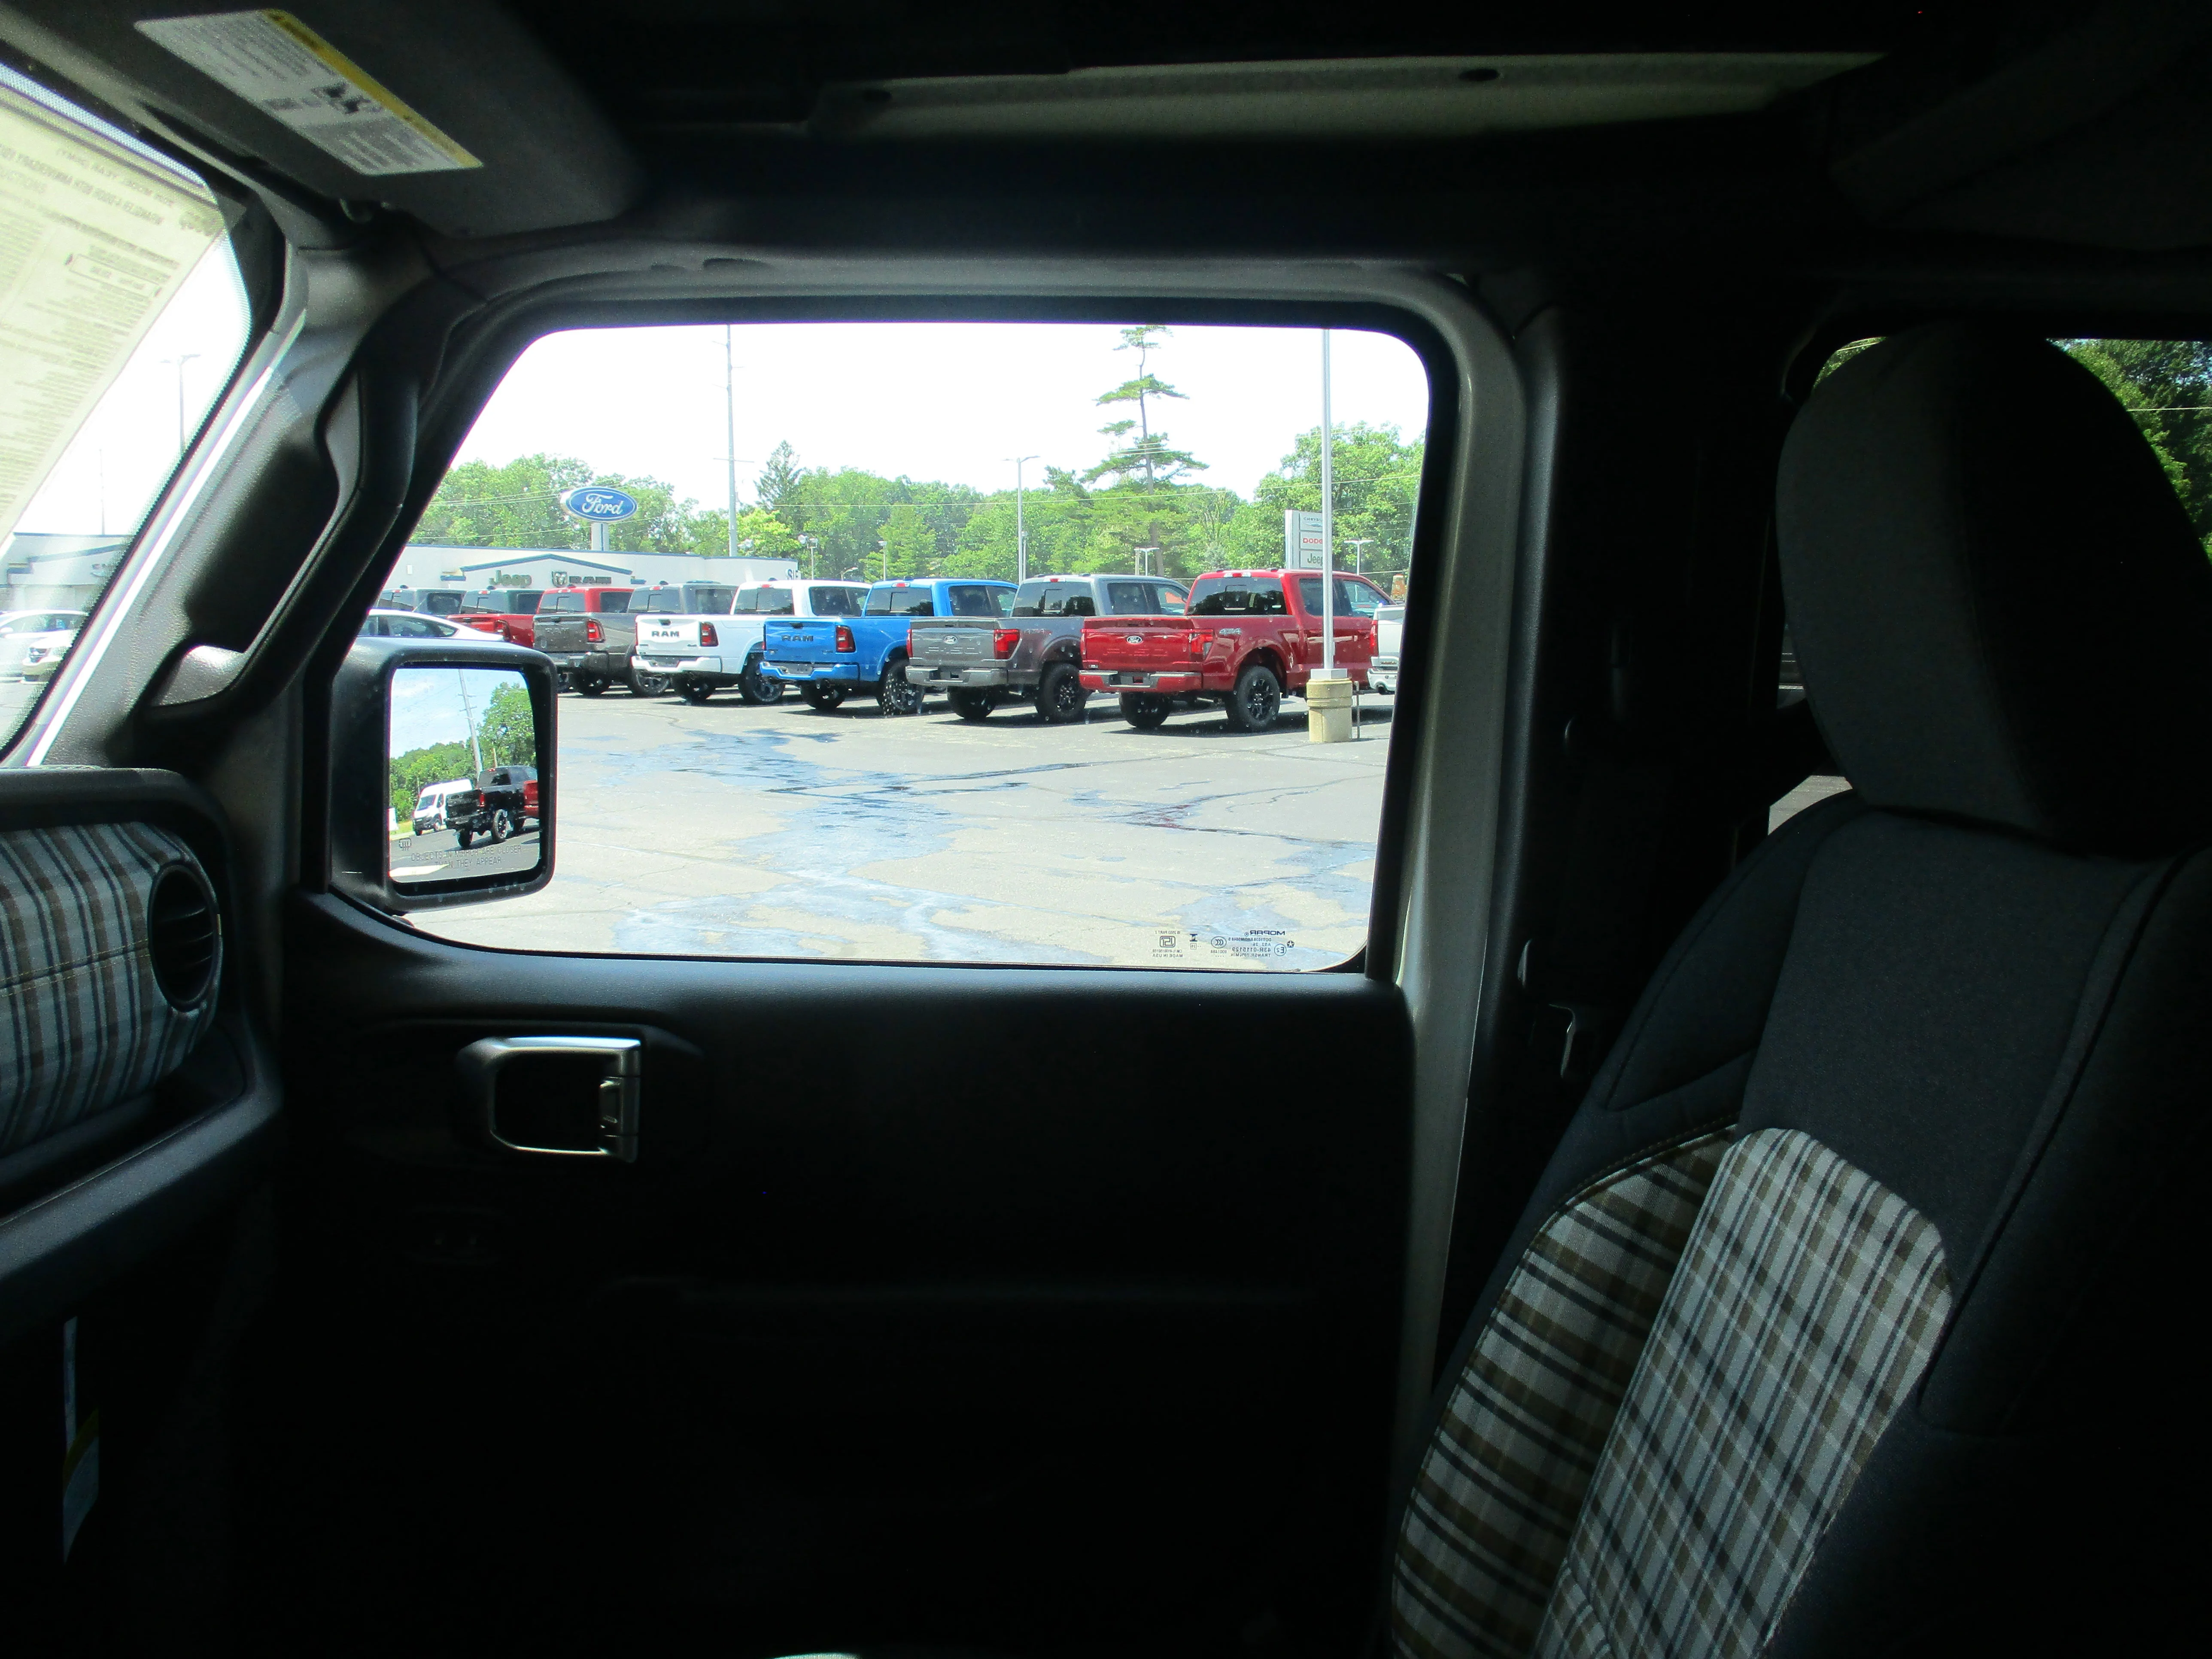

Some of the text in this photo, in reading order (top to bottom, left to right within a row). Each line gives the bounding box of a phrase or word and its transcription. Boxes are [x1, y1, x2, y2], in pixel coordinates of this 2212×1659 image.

[582, 493, 624, 515] Ford
[489, 569, 532, 589] Jeep
[568, 576, 612, 584] RAM
[411, 851, 442, 862] OBJECTS
[497, 845, 522, 854] CLOSER
[476, 856, 502, 866] APPEAR
